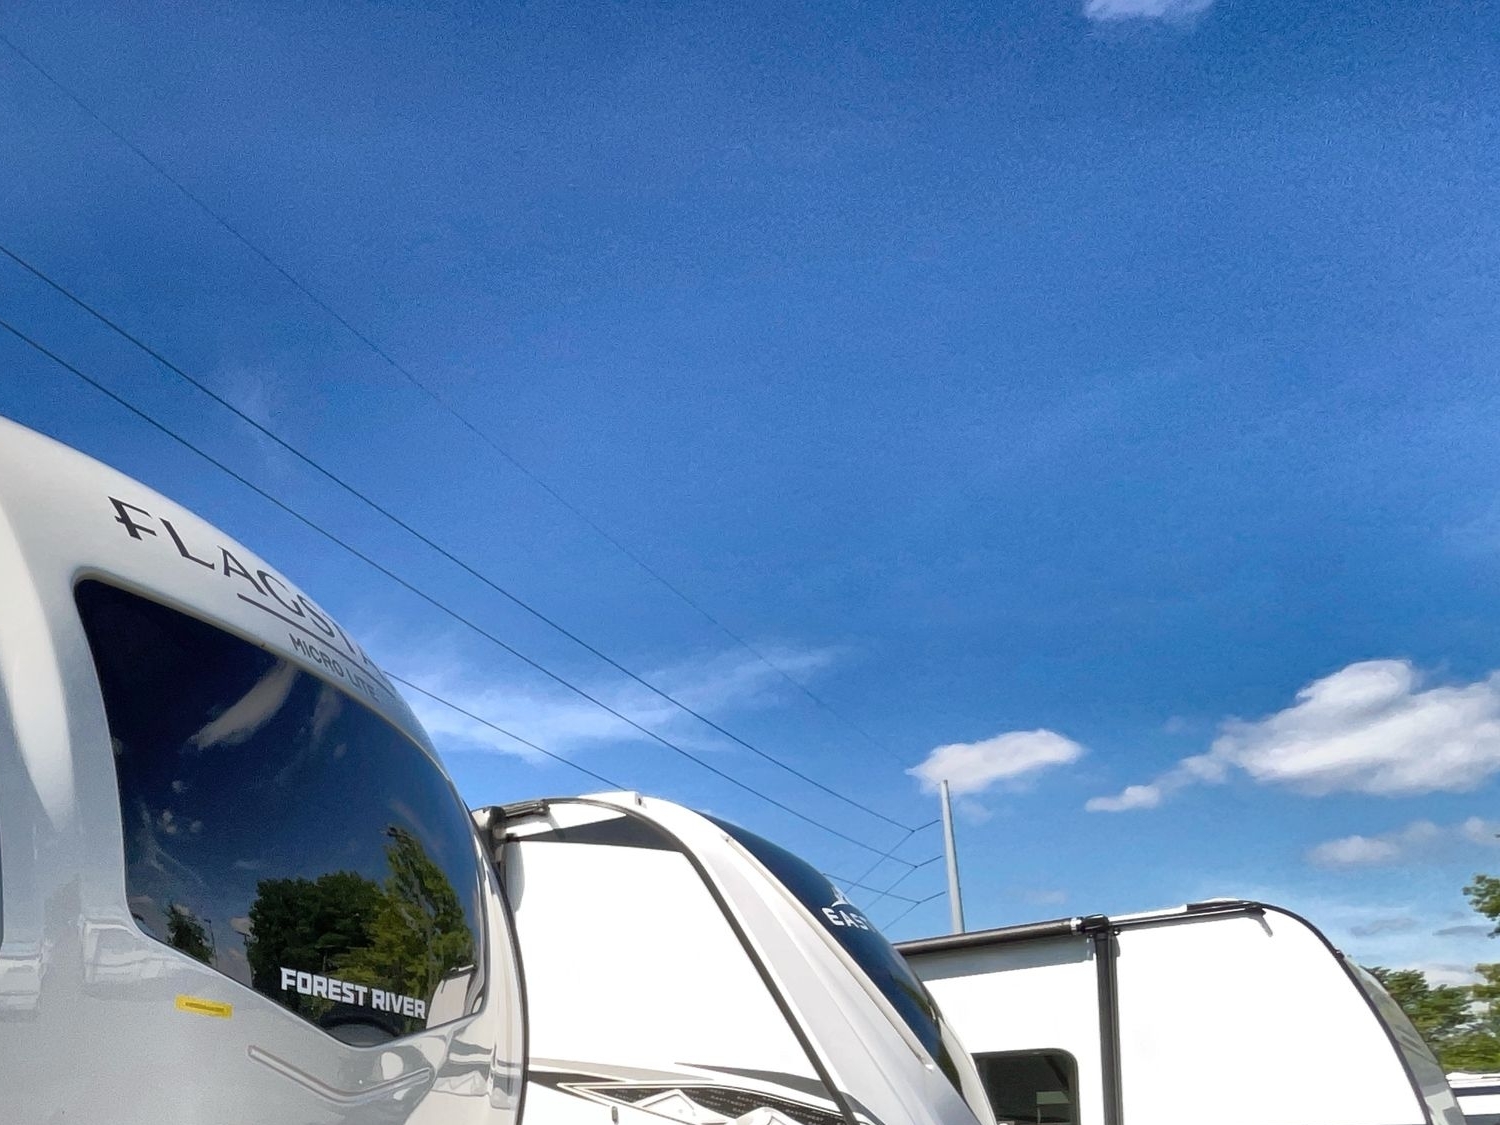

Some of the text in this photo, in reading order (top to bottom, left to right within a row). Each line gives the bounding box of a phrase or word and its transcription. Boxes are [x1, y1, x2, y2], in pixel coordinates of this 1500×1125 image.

[288, 632, 380, 702] MICRO LITE
[280, 967, 426, 1019] FOREST RIVER
